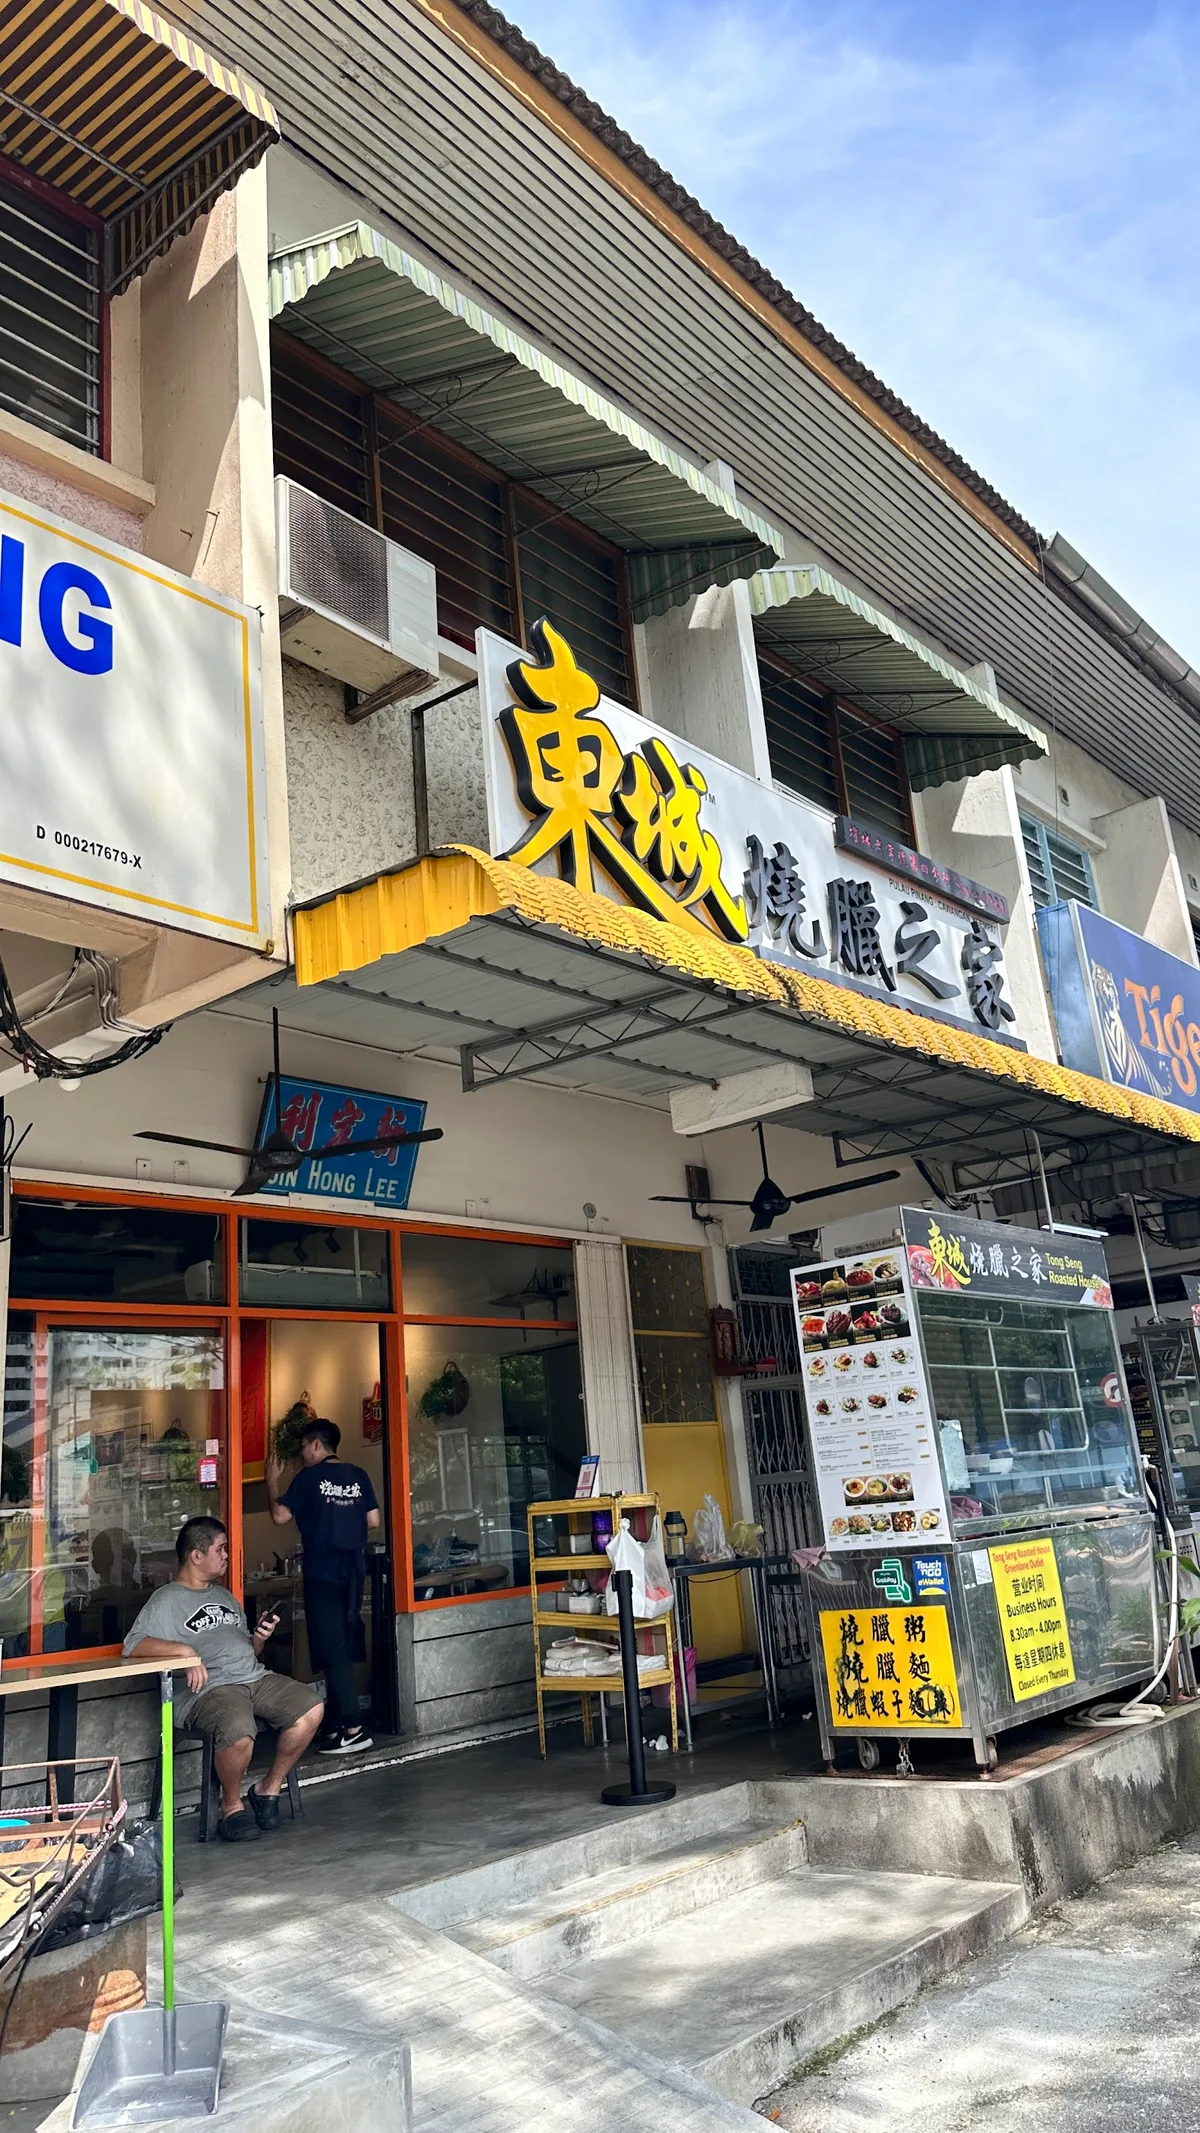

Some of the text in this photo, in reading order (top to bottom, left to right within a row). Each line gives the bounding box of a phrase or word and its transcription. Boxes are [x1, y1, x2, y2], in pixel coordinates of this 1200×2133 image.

[499, 614, 757, 958] 東城
[36, 825, 142, 869] D 000217679-X
[888, 878, 910, 896] PULAU
[910, 888, 934, 906] PINANG
[926, 1217, 972, 1285] 東城
[1045, 1252, 1084, 1273] Tong Seng
[1049, 1270, 1100, 1289] Roasted House
[915, 1560, 942, 1569] Touch
[992, 1545, 1050, 1562] Tong Seng Roasted House
[1004, 1558, 1045, 1573] Greenlane Outlet
[918, 1578, 945, 1586] eWallet
[1011, 1574, 1045, 1597] 营业时间
[1006, 1596, 1057, 1617] Business Hours
[1010, 1626, 1035, 1642] 8.30am
[1039, 1619, 1062, 1635] 4.00pm
[1018, 1667, 1070, 1691] Closed Every Thursday
